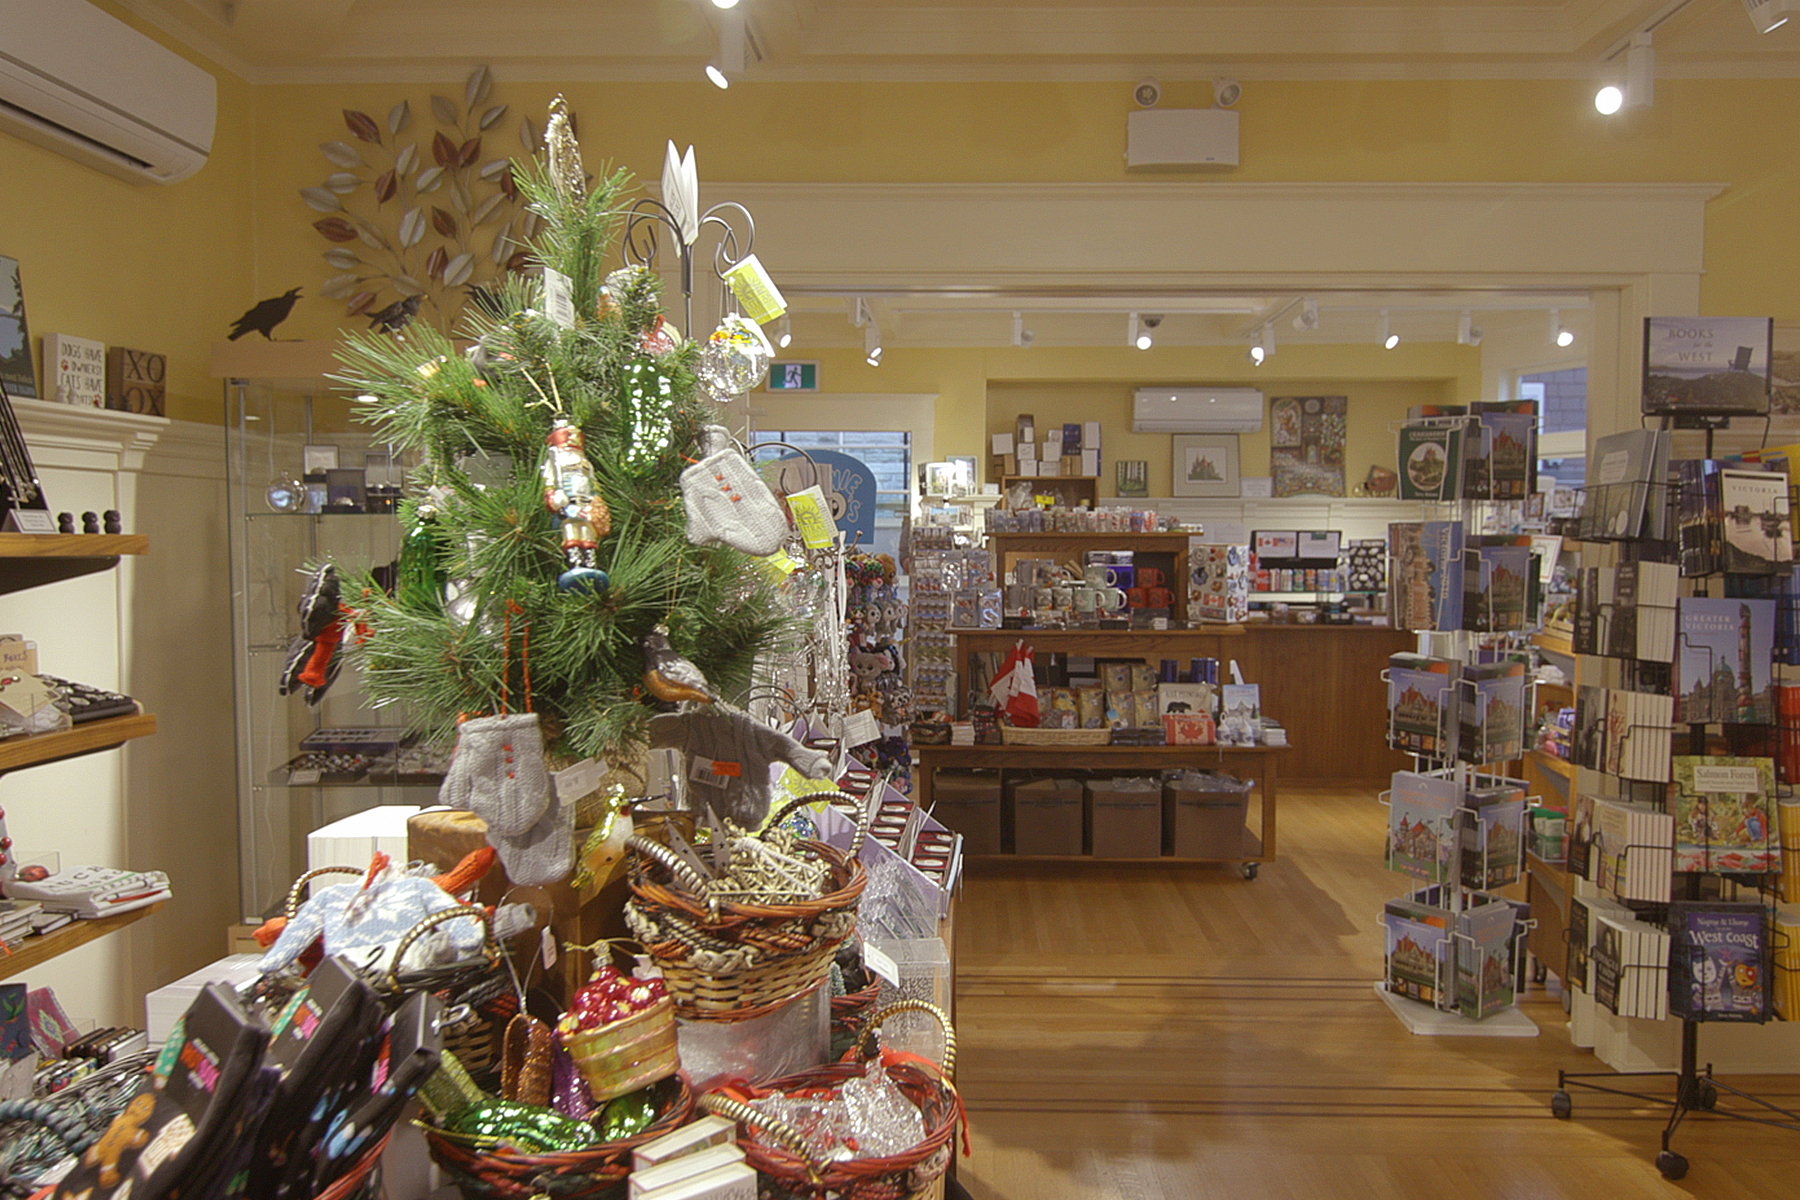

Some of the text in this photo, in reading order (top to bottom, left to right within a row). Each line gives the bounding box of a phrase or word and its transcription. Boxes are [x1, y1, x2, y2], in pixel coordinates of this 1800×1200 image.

[1669, 329, 1713, 338] BOOKS
[61, 342, 103, 363] DOGS HAVE
[1679, 352, 1713, 361] WEST
[126, 349, 166, 384] XO
[61, 373, 103, 394] CATS HAVE
[1731, 485, 1778, 494] VICTORIA
[1685, 614, 1731, 622] GREATER
[1685, 622, 1735, 631] VICTORIA
[1696, 768, 1756, 780] Salmon Forest
[1688, 930, 1759, 950] West Coast
